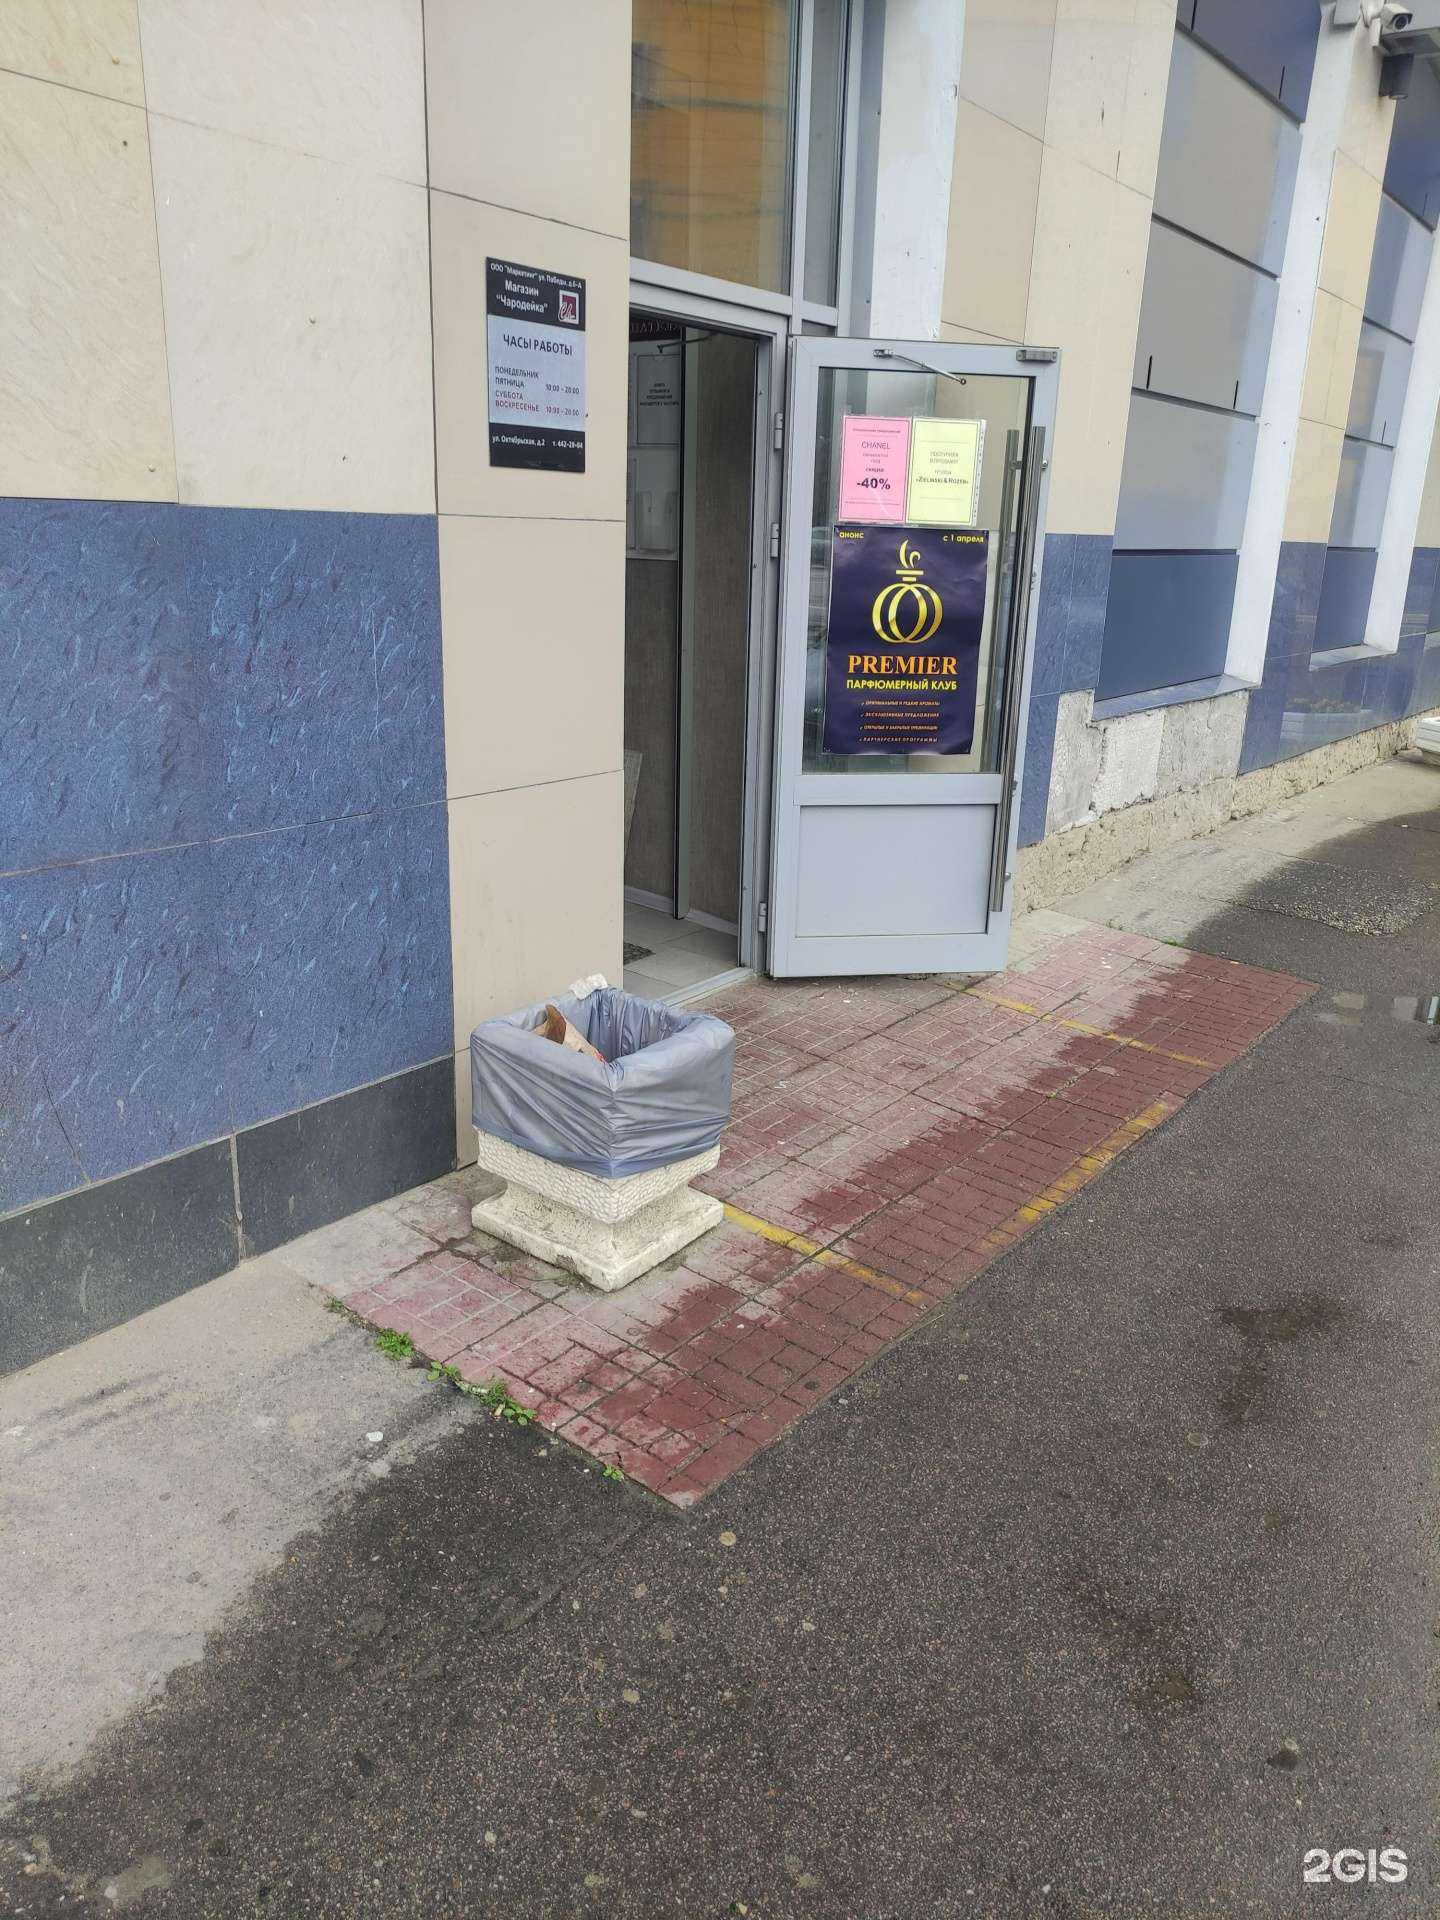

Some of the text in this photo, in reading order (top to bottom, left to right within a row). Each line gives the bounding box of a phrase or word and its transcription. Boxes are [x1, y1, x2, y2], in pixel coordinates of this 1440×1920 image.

[490, 262, 504, 273] ООО
[504, 279, 539, 297] Магазин
[496, 293, 548, 313] "Чародейка"
[503, 334, 573, 356] ЧАСЫ РАБОТЫ
[494, 366, 539, 379] ПОНЕДЕЛЬНИК
[495, 377, 525, 389] ПЯТНИЦА
[495, 390, 523, 401] СУББОТА
[495, 400, 539, 412] ВОСКРЕСЕНЬЕ
[492, 435, 500, 444] ул.
[861, 440, 891, 450] CHANEL
[857, 477, 891, 490] -40%
[839, 531, 864, 539] анонс
[956, 535, 984, 543] апреля
[847, 655, 959, 675] PREMIER
[846, 679, 957, 690] ПАРФЮМЕРНЫЙ КЛУБ
